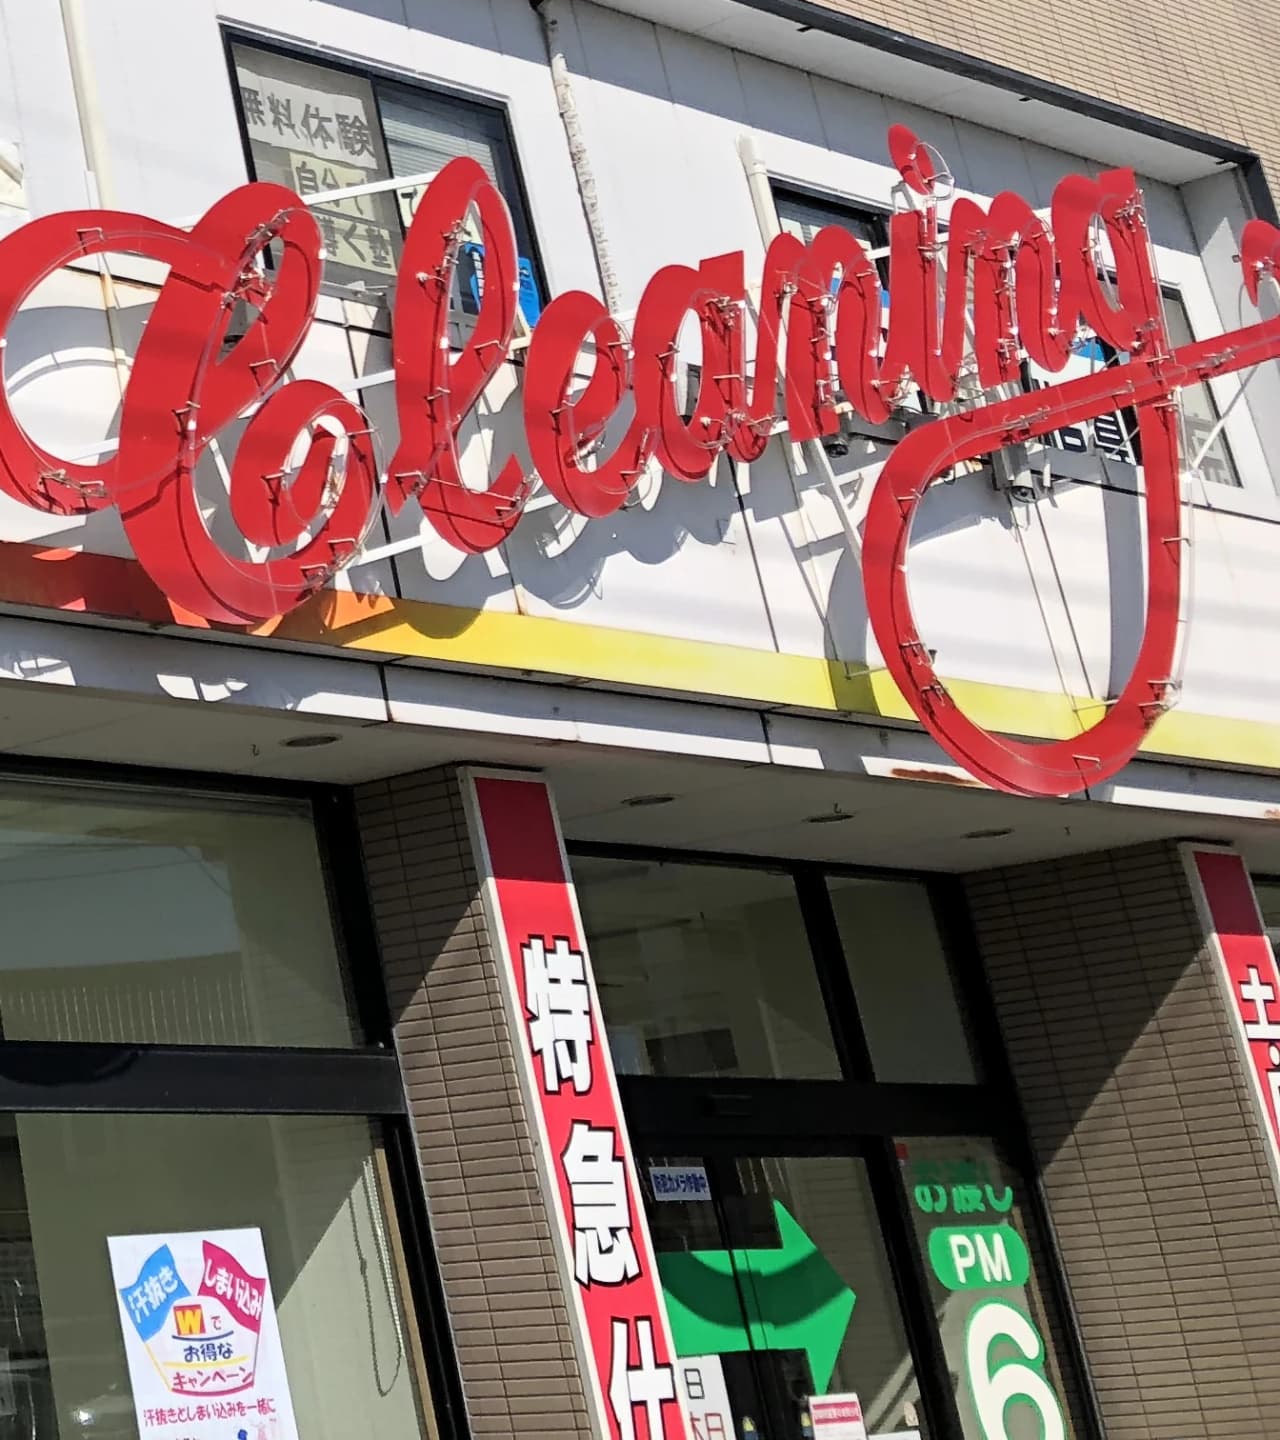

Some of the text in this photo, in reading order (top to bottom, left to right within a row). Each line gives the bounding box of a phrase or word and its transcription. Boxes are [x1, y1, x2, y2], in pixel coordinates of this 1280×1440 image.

[948, 1232, 1013, 1285] PM
[127, 1265, 179, 1324] 汗抜き
[204, 1258, 264, 1321] しまい込み
[172, 1366, 253, 1390] キャンペーン
[183, 1342, 234, 1363] お得な
[965, 1298, 1067, 1440] 6
[143, 1397, 277, 1427] 汗抜きとしまい込みを一緒に
